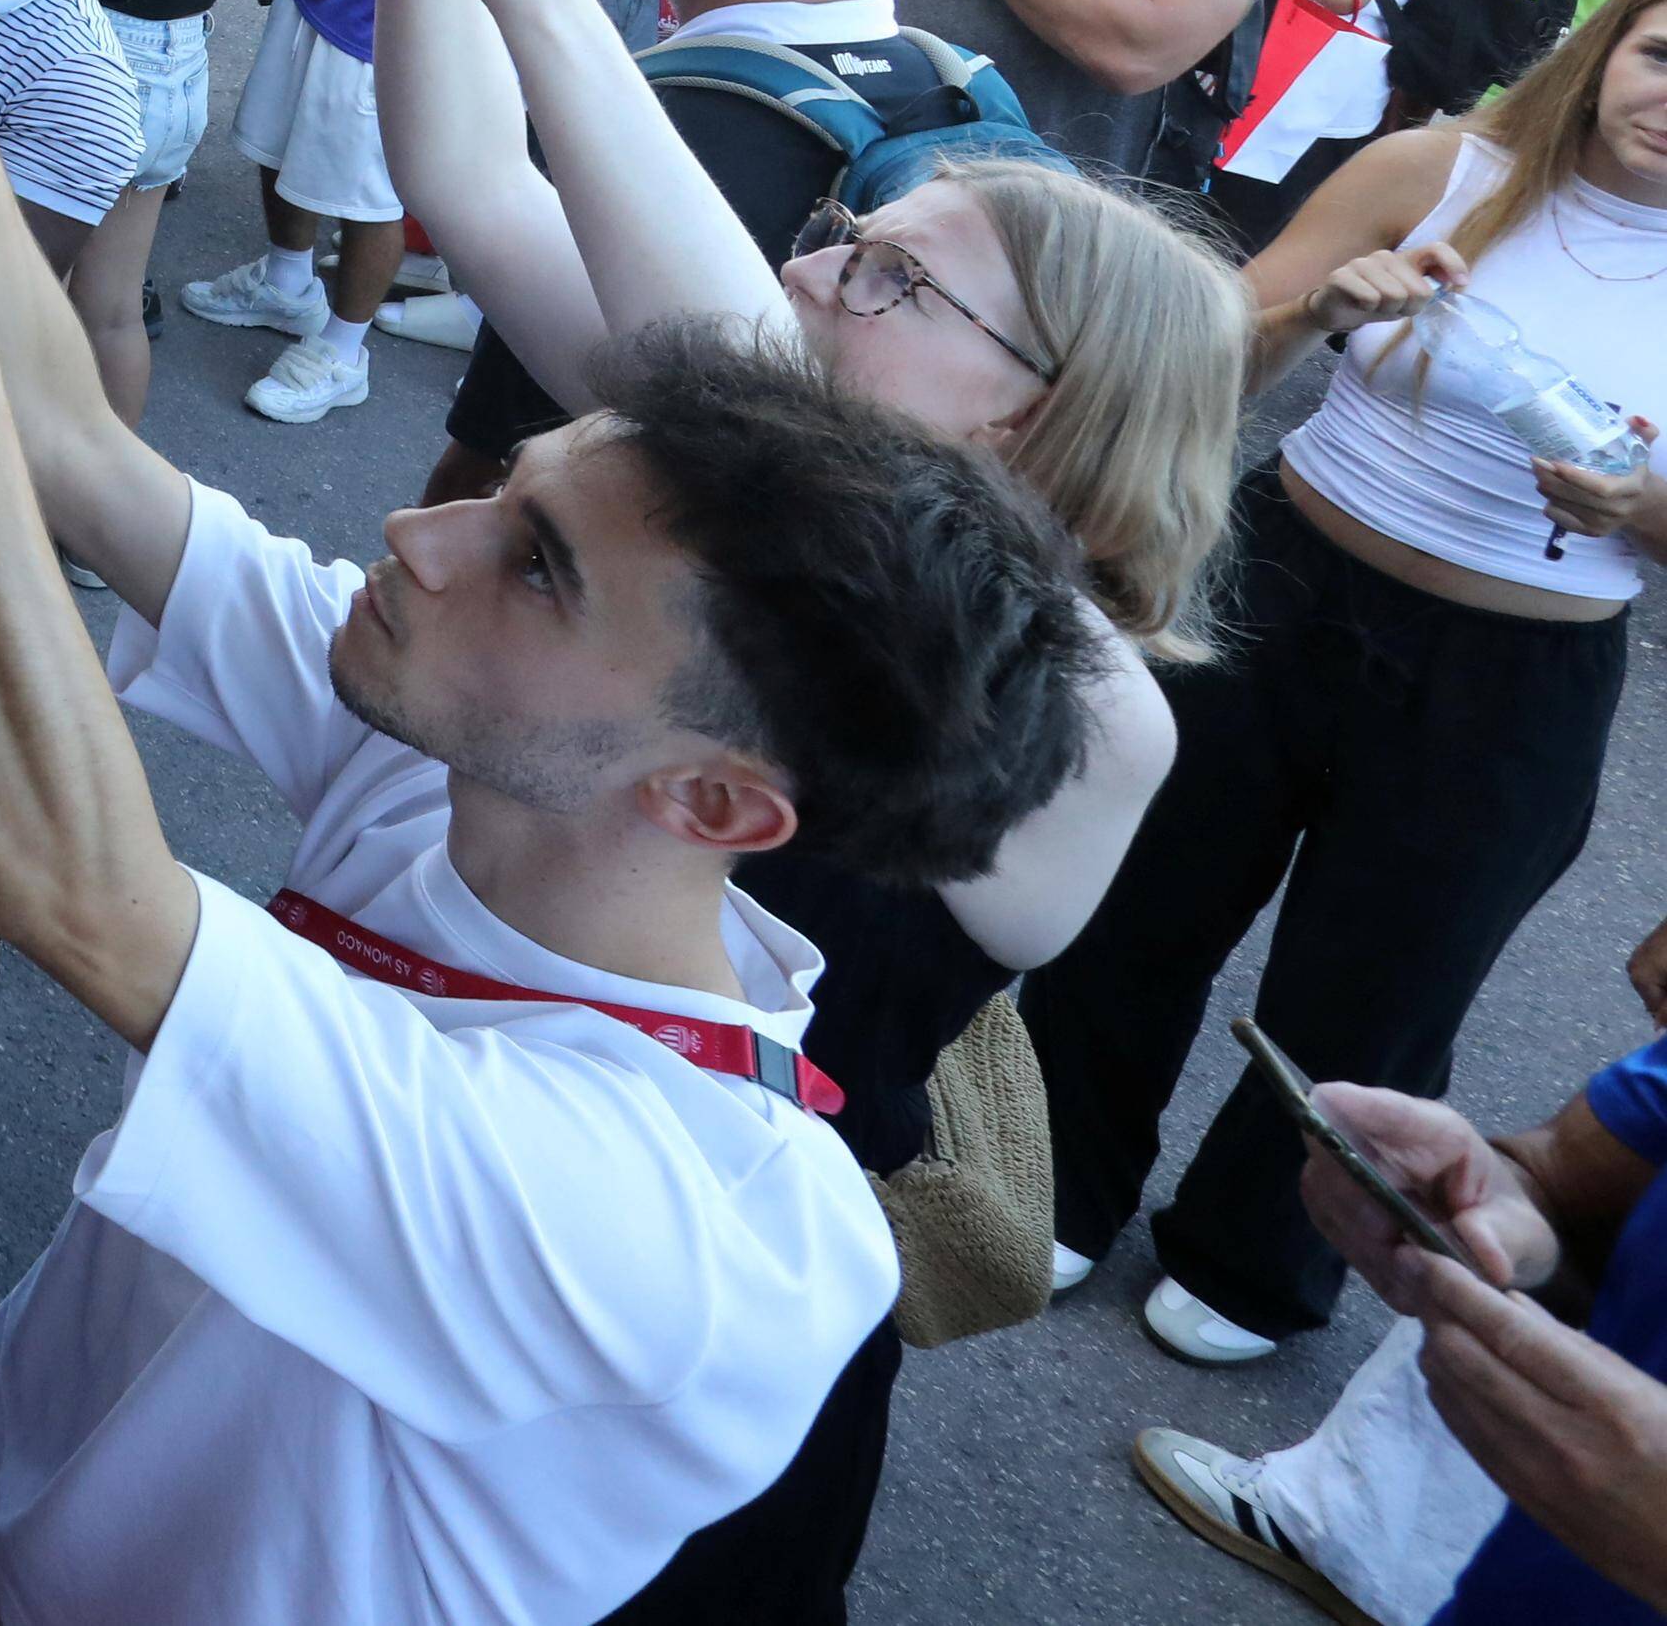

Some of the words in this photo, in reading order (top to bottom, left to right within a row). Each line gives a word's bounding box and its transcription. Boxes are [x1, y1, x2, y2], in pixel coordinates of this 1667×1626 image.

[861, 58, 893, 74] YEARS
[336, 929, 394, 967] MONACO
[394, 957, 413, 977] AS
